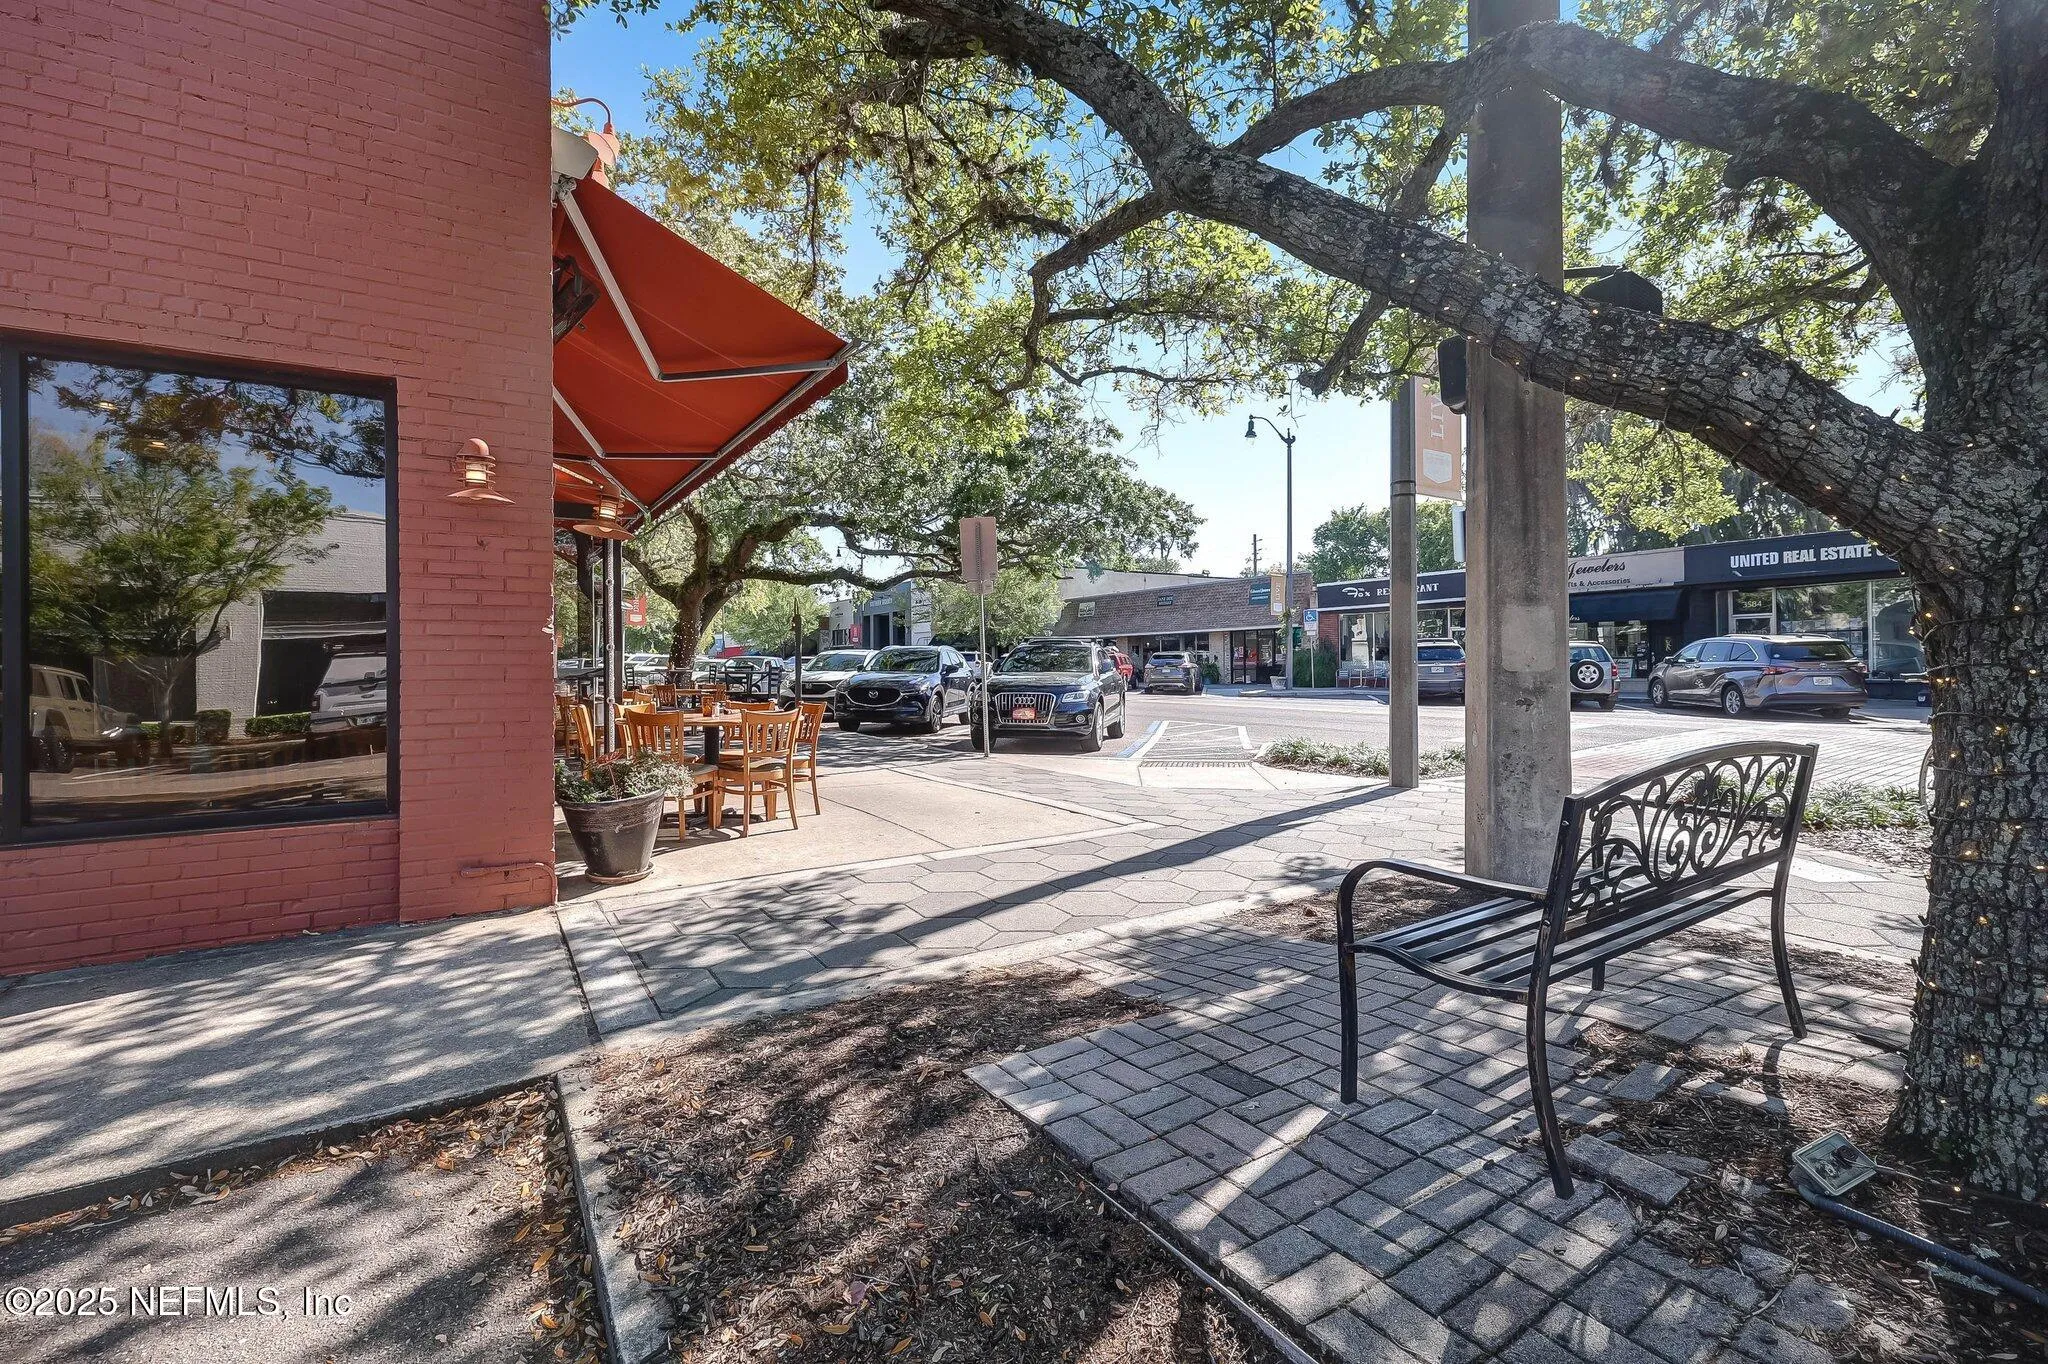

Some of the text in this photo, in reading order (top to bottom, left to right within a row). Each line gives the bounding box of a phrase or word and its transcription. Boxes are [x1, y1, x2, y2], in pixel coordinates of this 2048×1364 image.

[1430, 395, 1444, 439] LIV
[1730, 551, 1779, 569] UNITED
[1783, 547, 1817, 564] REAL
[1820, 544, 1872, 561] ESTATE
[1568, 558, 1626, 579] Jewelers
[1376, 582, 1440, 596] RERANT
[1587, 577, 1631, 587] Accessories
[1742, 600, 1762, 609] 3584
